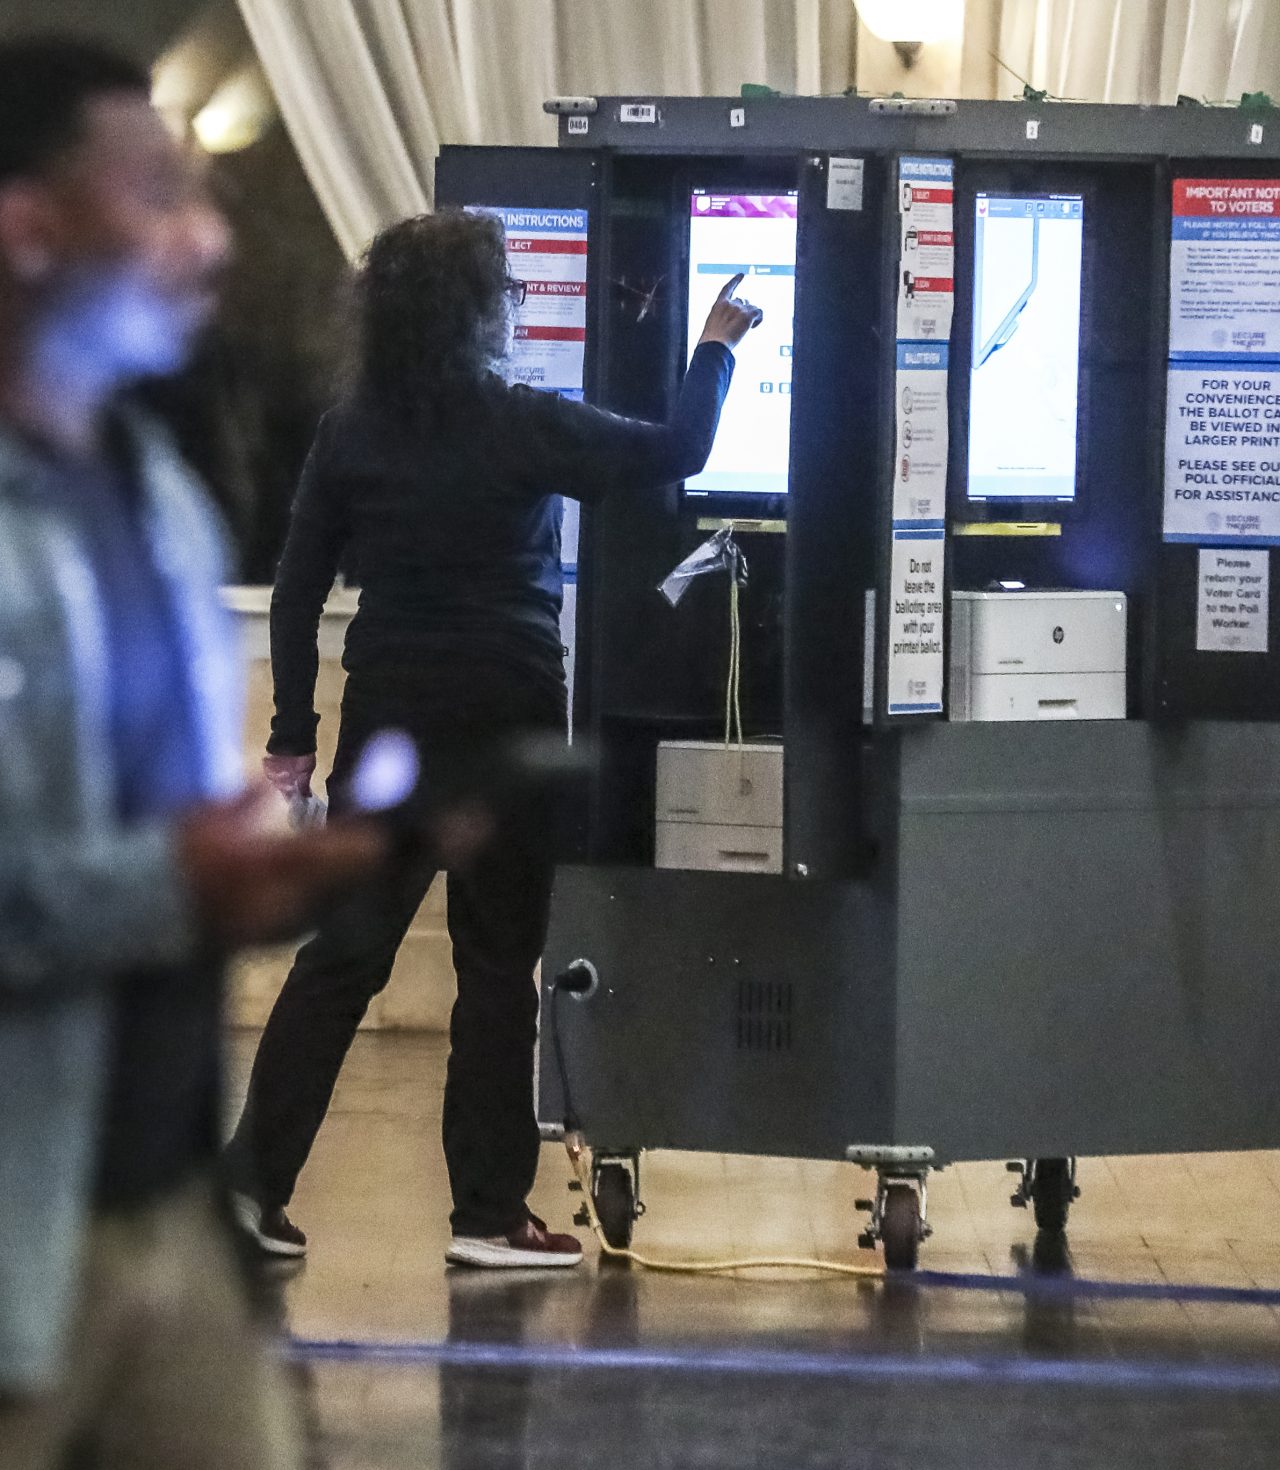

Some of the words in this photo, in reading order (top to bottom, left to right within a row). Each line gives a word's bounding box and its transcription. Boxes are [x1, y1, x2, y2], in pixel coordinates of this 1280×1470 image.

[1186, 187, 1254, 198] IMPORTANT
[1210, 201, 1226, 212] TO
[1229, 201, 1274, 213] VOTERS
[508, 214, 583, 227] INSTRUCTIONS
[510, 242, 532, 250] LECT
[547, 284, 580, 292] REVIEW
[1202, 380, 1228, 390] FOR
[1233, 381, 1271, 391] YOUR
[1186, 393, 1280, 405] CONVENIENCE
[1179, 407, 1204, 417] THE
[1208, 408, 1259, 418] BALLOT
[1190, 421, 1206, 431] BE
[1211, 422, 1262, 432] VIEWED
[1266, 423, 1280, 433] IN
[1185, 435, 1237, 445] LARGER
[1241, 436, 1280, 446] PRINT
[1178, 460, 1227, 470] PLEASE
[1232, 461, 1255, 471] SEE
[1185, 474, 1218, 484] POLL
[1222, 474, 1280, 485] OFFICIAL
[1175, 489, 1201, 500] FOR
[1206, 490, 1280, 502] ASSISTANC
[910, 559, 919, 573] Do
[922, 561, 931, 573] not
[1217, 558, 1251, 568] Please
[1205, 574, 1236, 582] return
[1239, 576, 1262, 585] your
[905, 580, 922, 593] leave
[924, 580, 935, 593] the
[1205, 588, 1233, 597] Voter
[1236, 589, 1260, 598] Card
[896, 599, 925, 617] balloting
[927, 603, 942, 613] area
[1206, 604, 1217, 612] to
[1220, 604, 1236, 613] the
[1239, 604, 1258, 613] Poll
[904, 619, 918, 633] with
[920, 623, 935, 637] your
[894, 639, 919, 657] printed
[921, 639, 942, 654] ballot.
